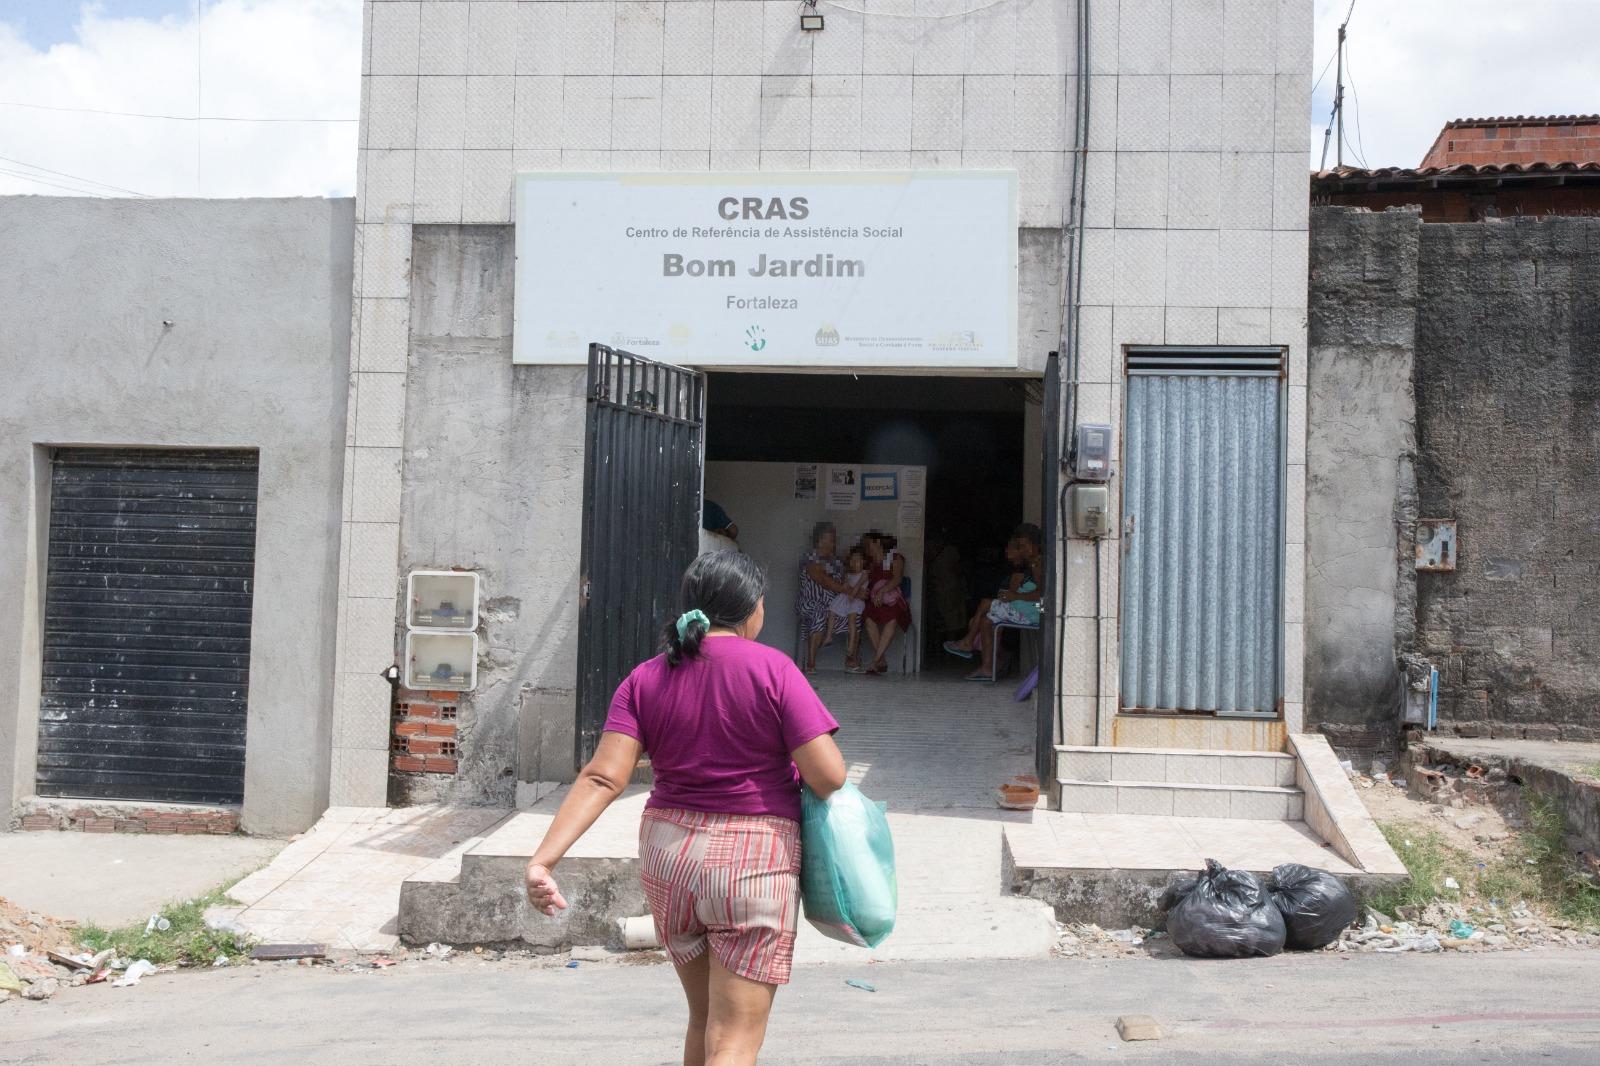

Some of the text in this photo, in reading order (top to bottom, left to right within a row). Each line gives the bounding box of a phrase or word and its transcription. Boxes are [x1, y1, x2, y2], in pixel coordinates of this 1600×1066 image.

[717, 196, 810, 220] CRAS
[626, 226, 903, 238] Centro de Referência de Assistência Social
[662, 253, 865, 277] Bom Jardim
[726, 295, 798, 310] Fortaleza
